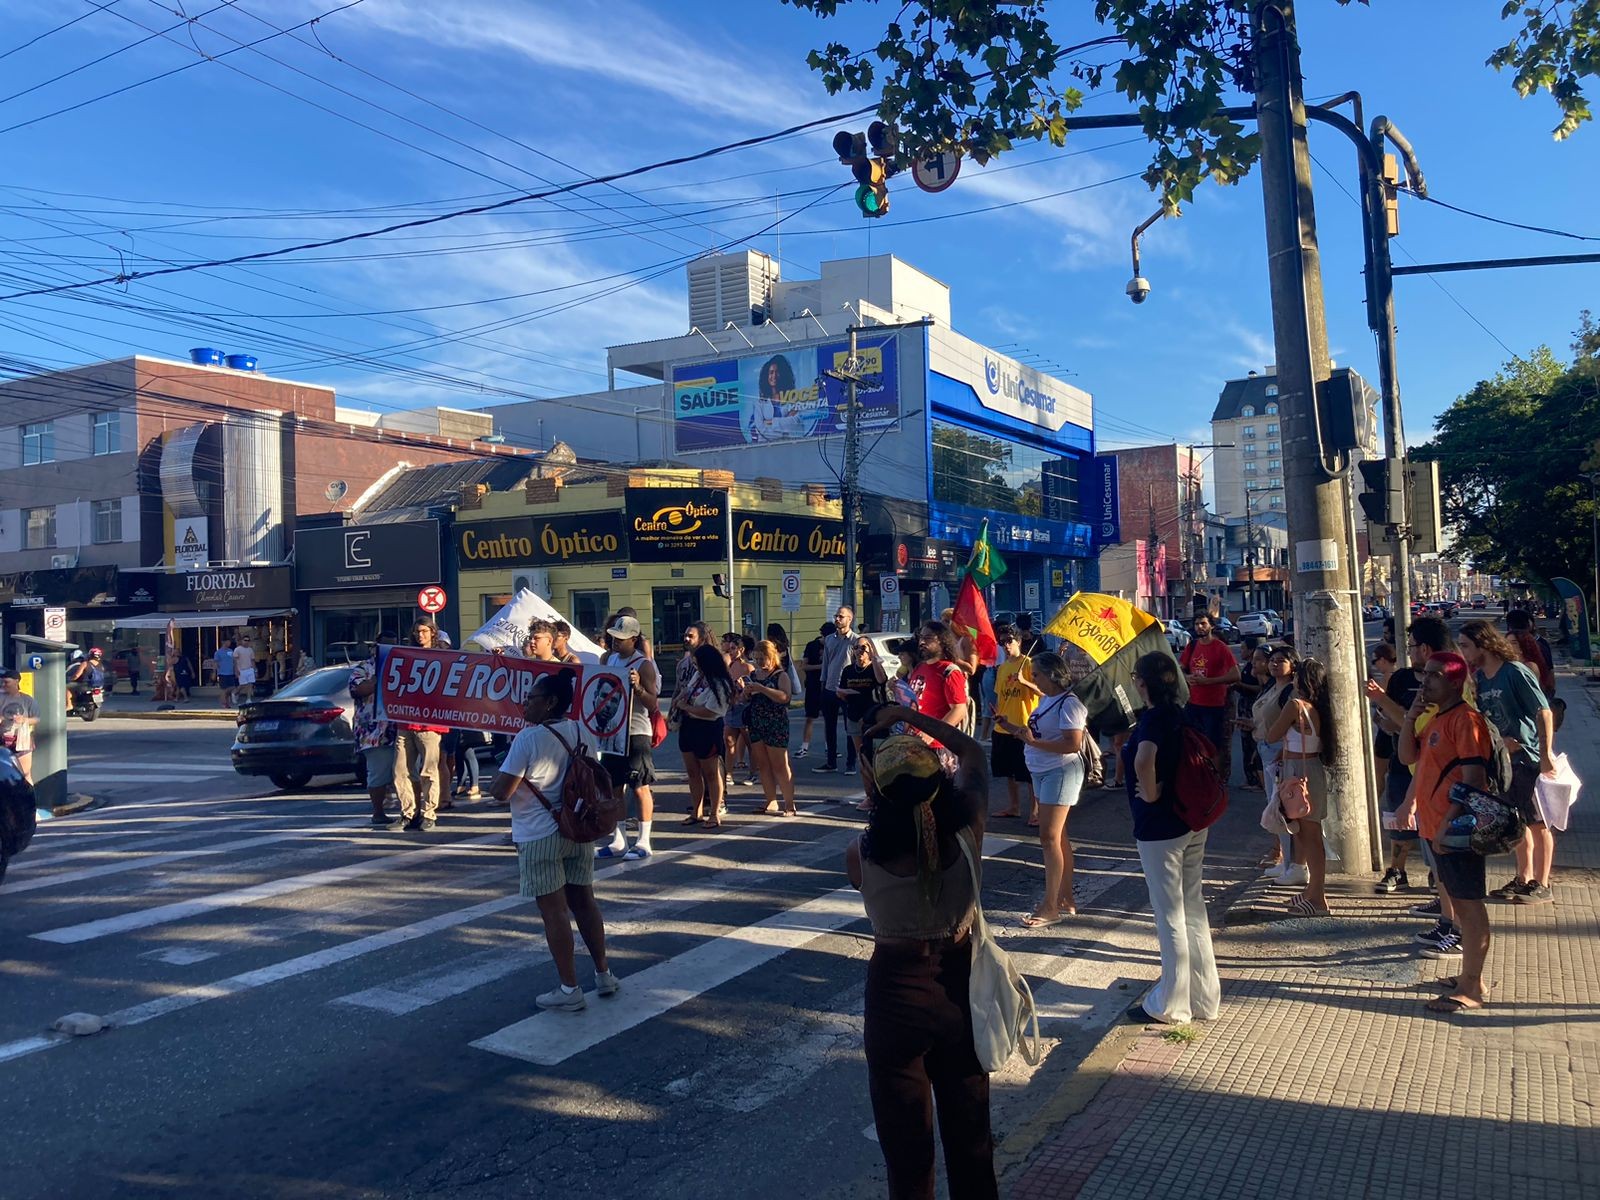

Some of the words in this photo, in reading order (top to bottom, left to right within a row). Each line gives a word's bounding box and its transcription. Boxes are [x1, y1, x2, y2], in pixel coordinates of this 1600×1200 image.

[680, 386, 739, 411] SAÚDE
[779, 384, 819, 405] VOCÊ
[1002, 371, 1056, 414] UniCesumar
[1103, 463, 1111, 520] UniCesumar
[685, 501, 719, 518] Óptico
[634, 517, 667, 531] Centro
[462, 530, 532, 560] Centro
[541, 523, 618, 559] Óptico
[737, 519, 799, 553] Centro
[174, 543, 208, 554] FLORYBAL
[186, 572, 255, 591] FLORYBAL
[787, 578, 795, 590] E
[886, 580, 893, 590] E
[32, 657, 42, 668] P
[387, 657, 442, 698] 5,50
[442, 655, 467, 697] É
[387, 704, 421, 718] CONTRA
[422, 708, 430, 718] O
[431, 709, 480, 724] AUMENTO
[481, 715, 497, 725] DA
